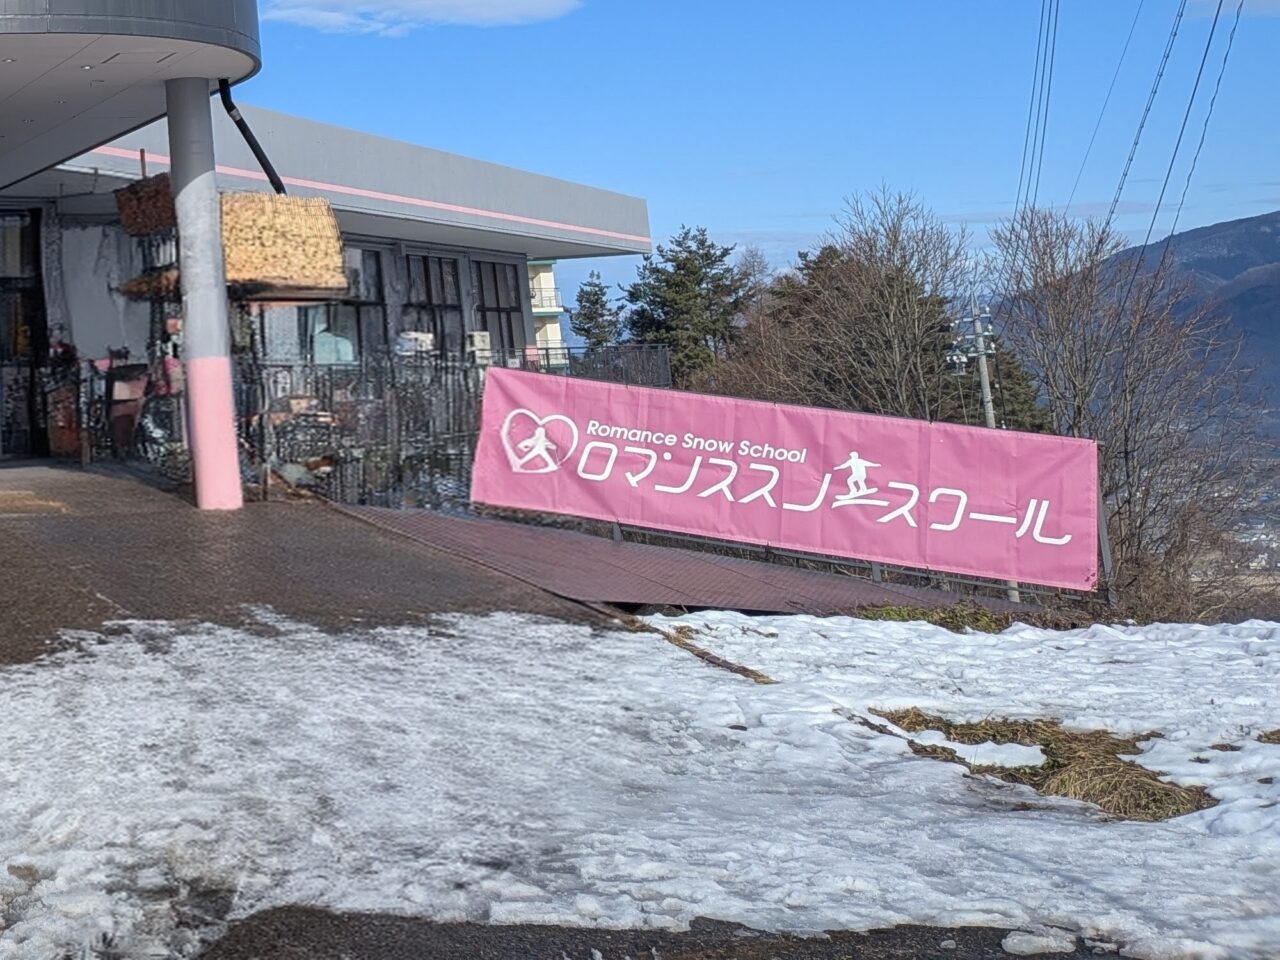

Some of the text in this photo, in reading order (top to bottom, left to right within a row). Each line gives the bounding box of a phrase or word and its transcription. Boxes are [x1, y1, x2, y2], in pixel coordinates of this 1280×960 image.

[586, 419, 807, 464] Romance Snow School
